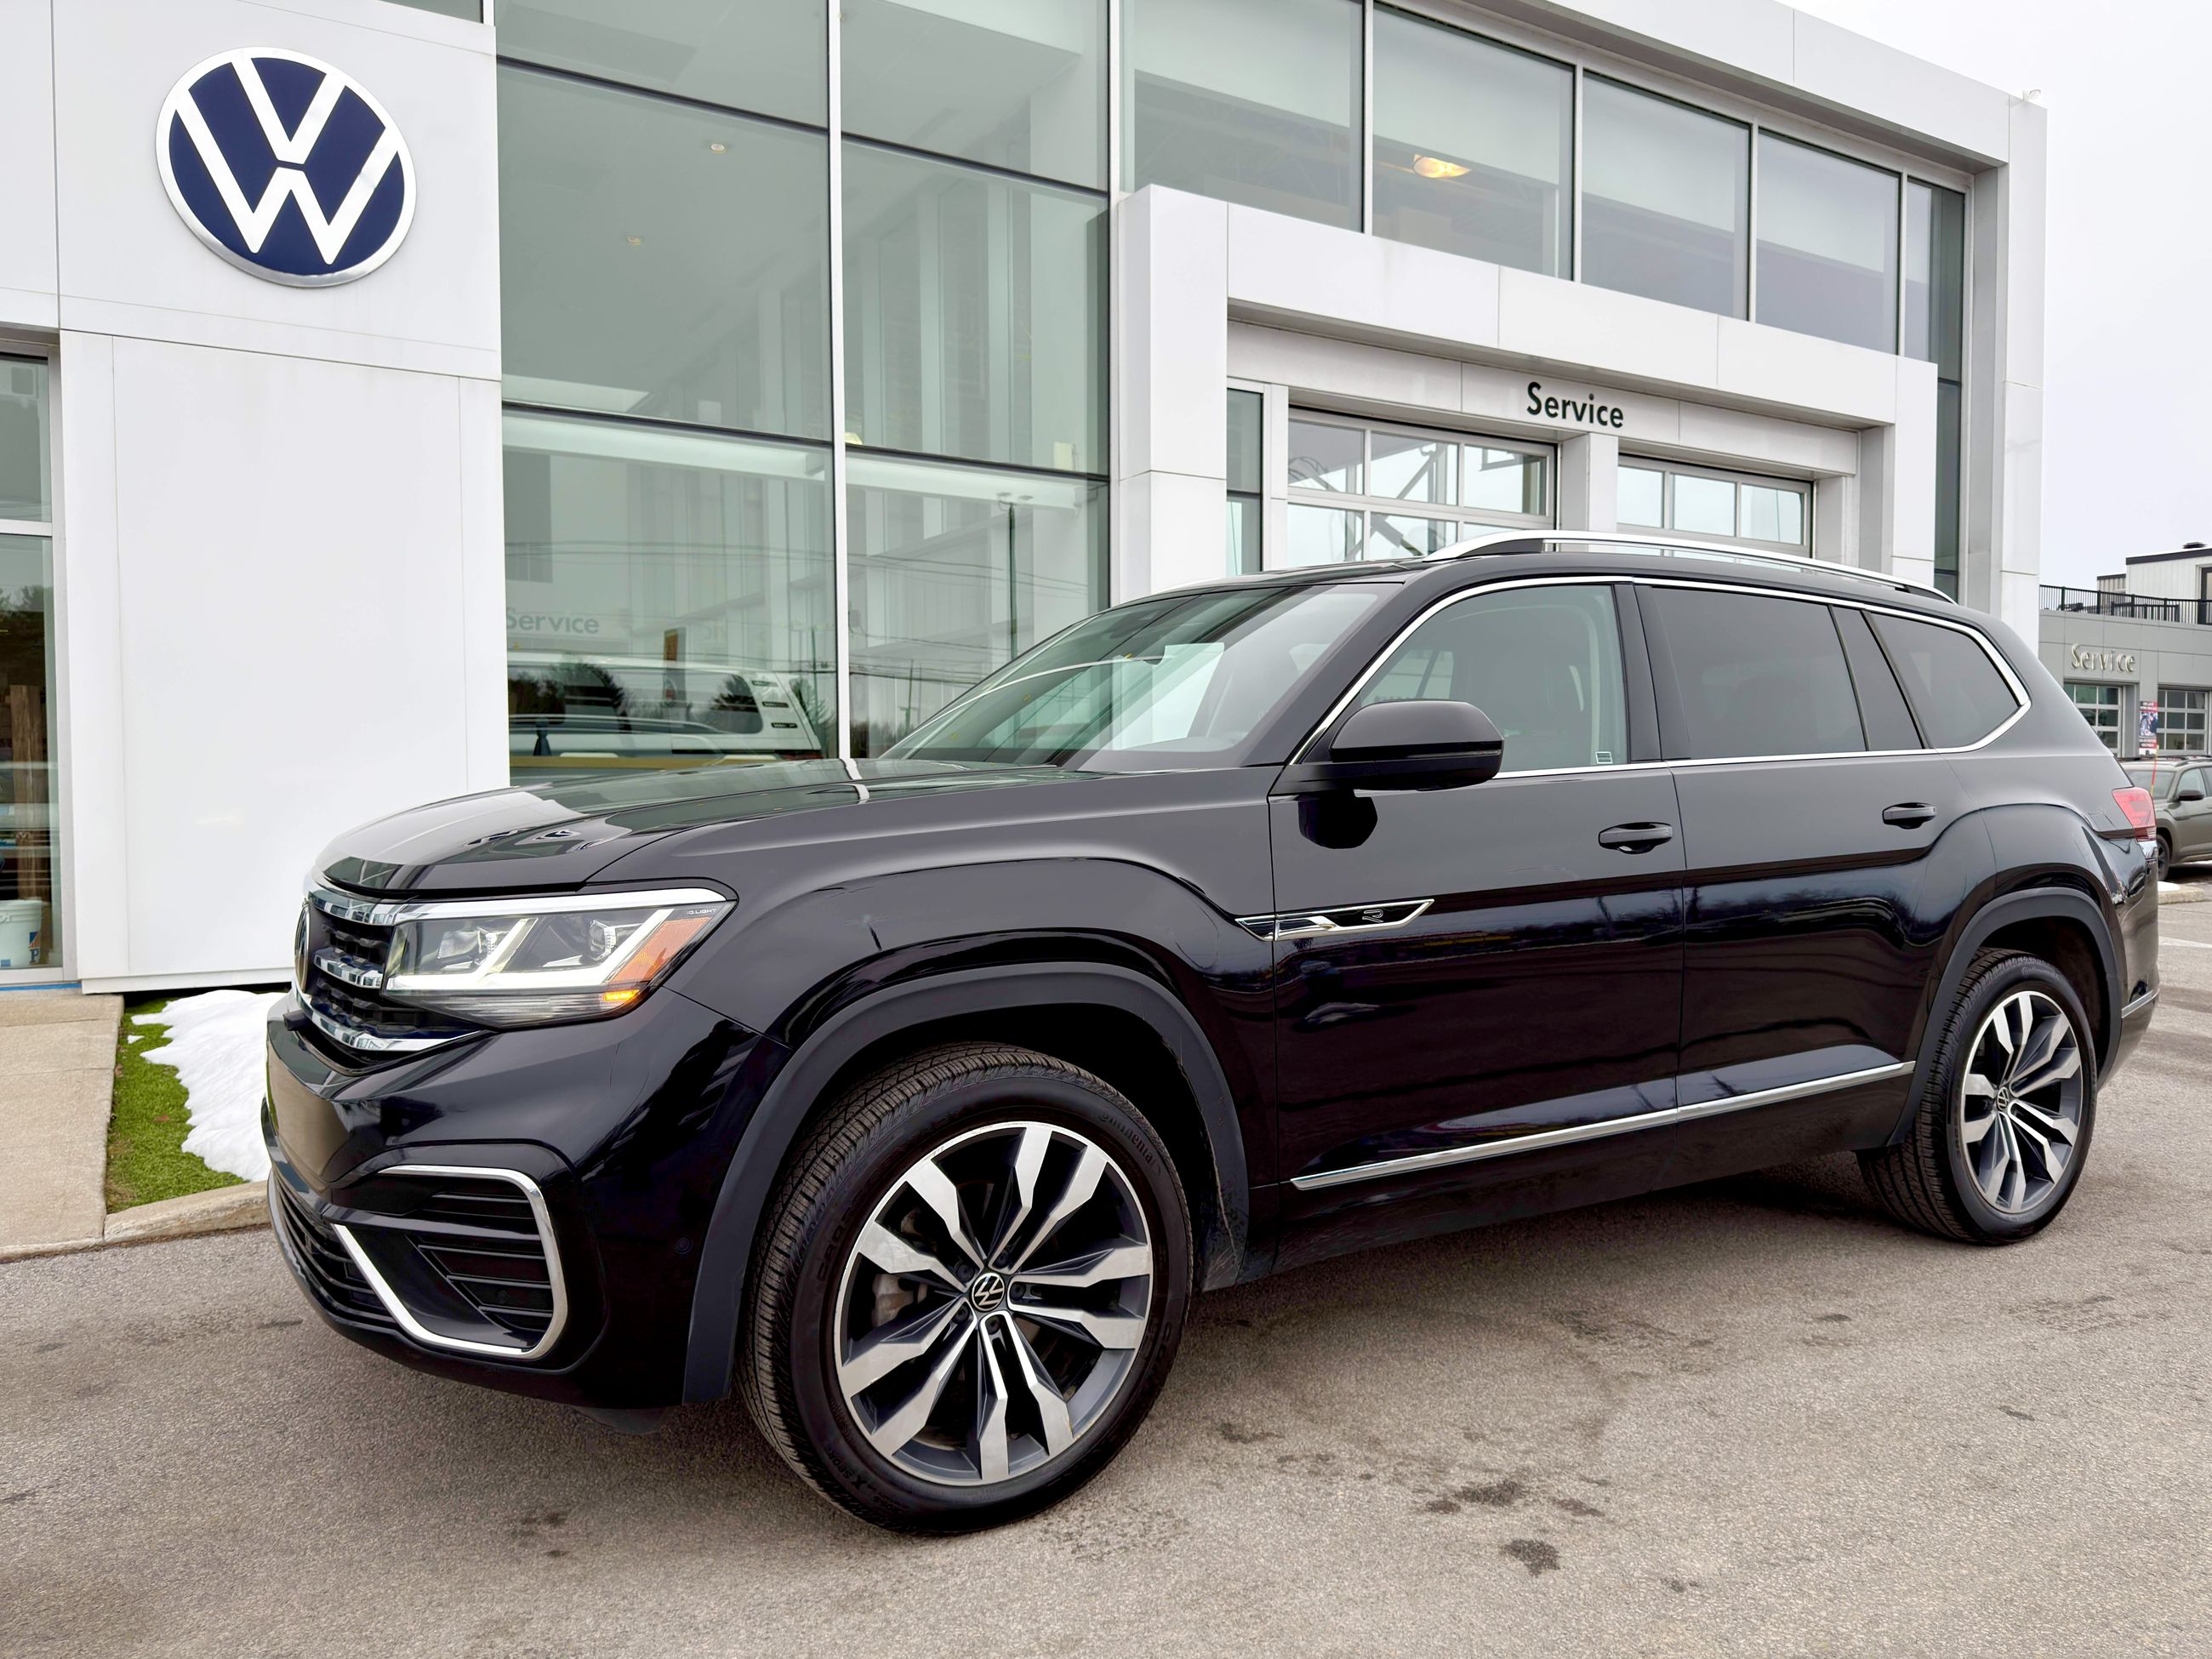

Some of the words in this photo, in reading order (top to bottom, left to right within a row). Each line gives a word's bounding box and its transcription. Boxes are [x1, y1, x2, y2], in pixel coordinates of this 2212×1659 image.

[167, 53, 403, 265] VW
[1526, 381, 1624, 429] Service
[506, 607, 600, 635] Service
[2071, 643, 2135, 672] Service
